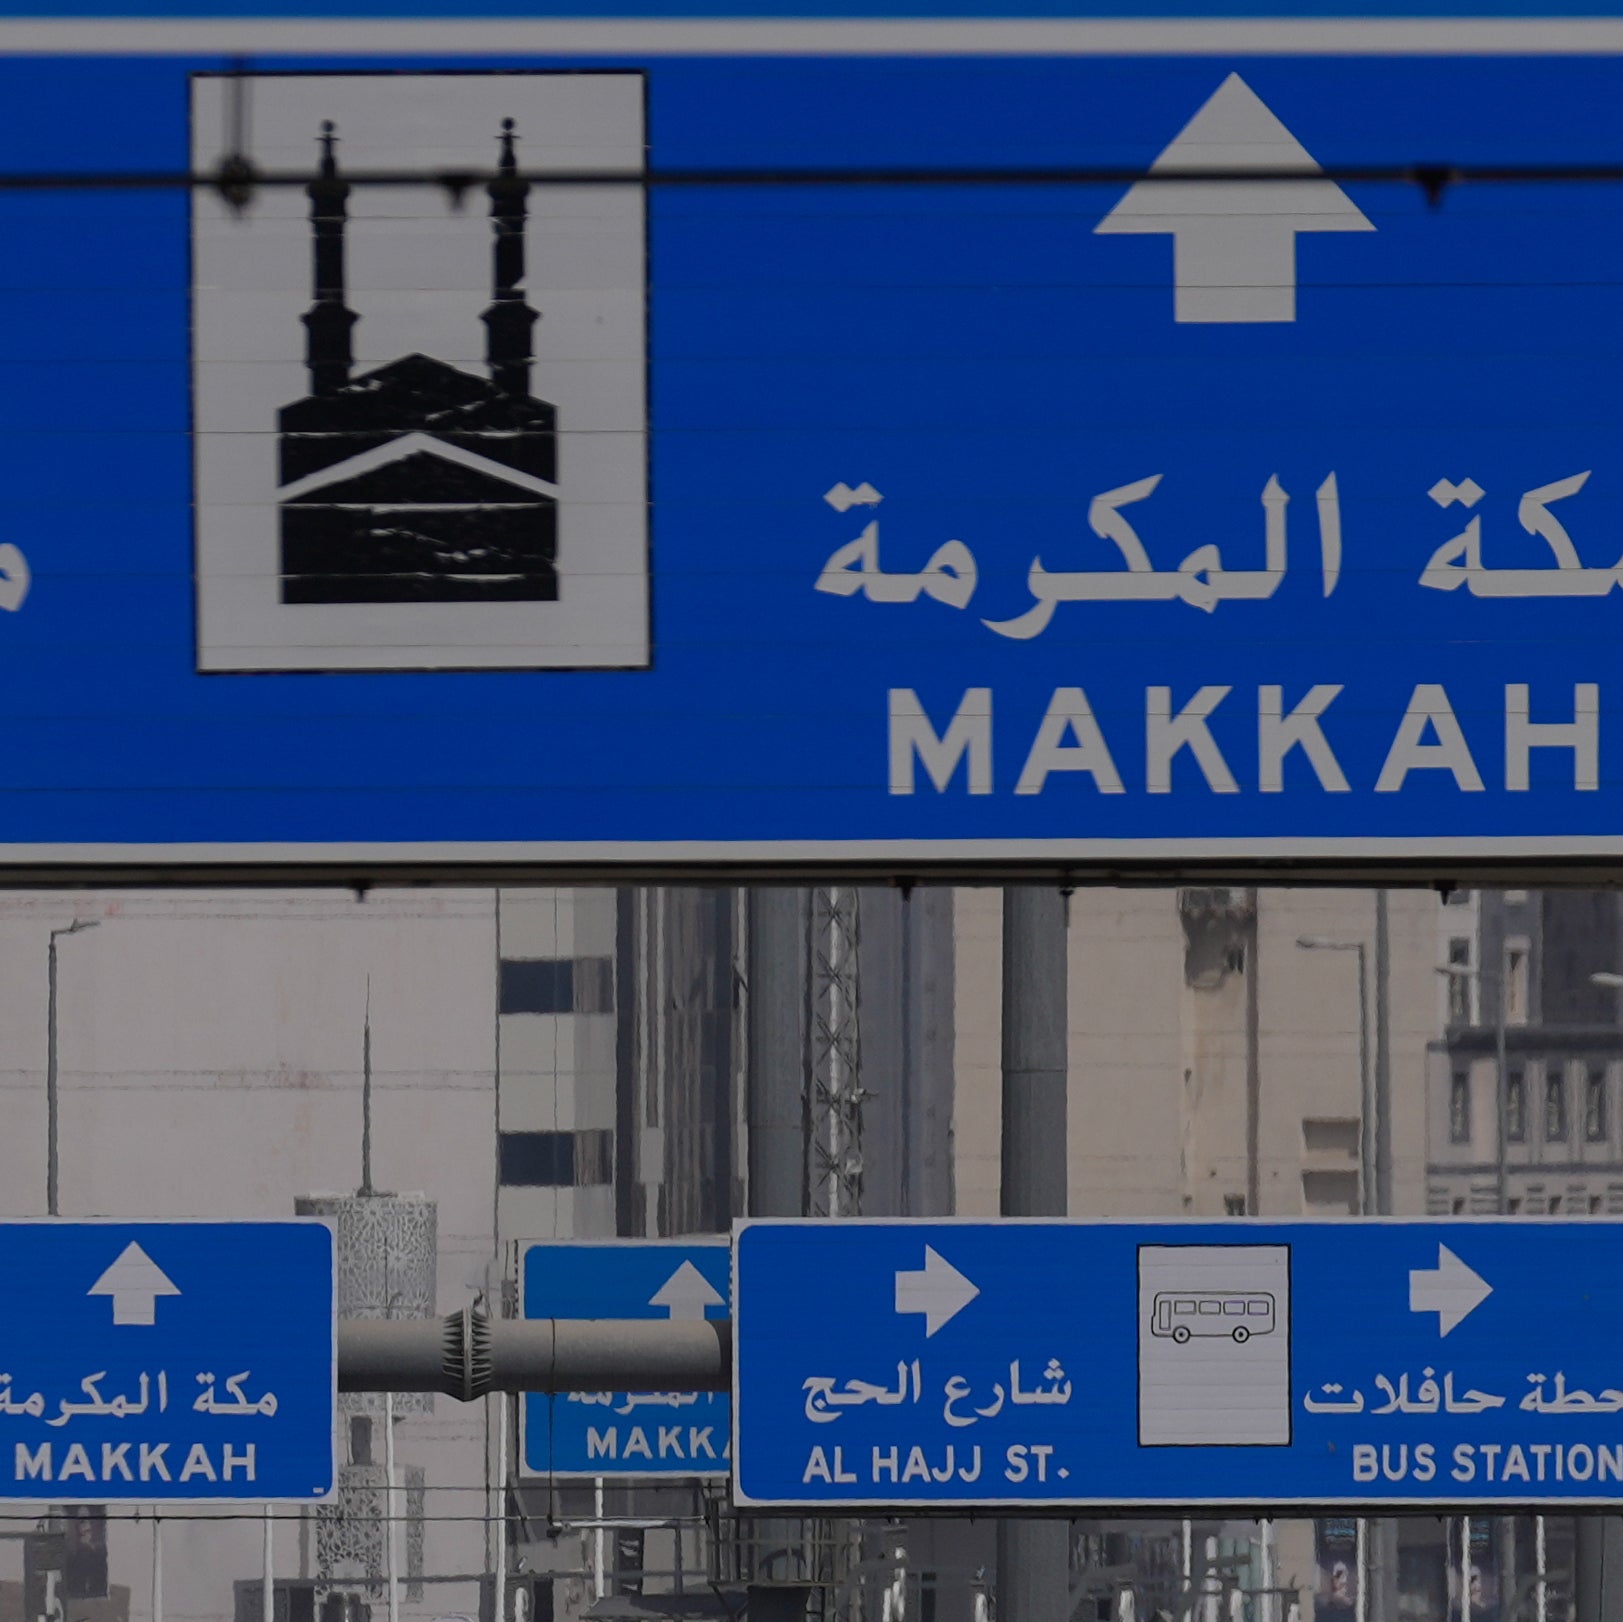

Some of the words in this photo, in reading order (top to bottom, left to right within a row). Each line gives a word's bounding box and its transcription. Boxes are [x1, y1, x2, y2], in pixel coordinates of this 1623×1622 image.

[815, 472, 1341, 639] المكرمة
[889, 684, 1598, 794] MAKKAH
[0, 1371, 167, 1426] المكرمة
[193, 1371, 277, 1416] مكة
[803, 1360, 921, 1422] الحج
[944, 1359, 1071, 1426] شارع
[1304, 1367, 1505, 1413] حافلات
[16, 1443, 255, 1481] MAKKAH
[587, 1427, 730, 1458] MAKK
[803, 1446, 857, 1482] AL
[873, 1446, 980, 1482] HAJJ
[1005, 1445, 1069, 1482] ST.
[1353, 1444, 1436, 1481] BUS
[1451, 1444, 1623, 1481] STATION
